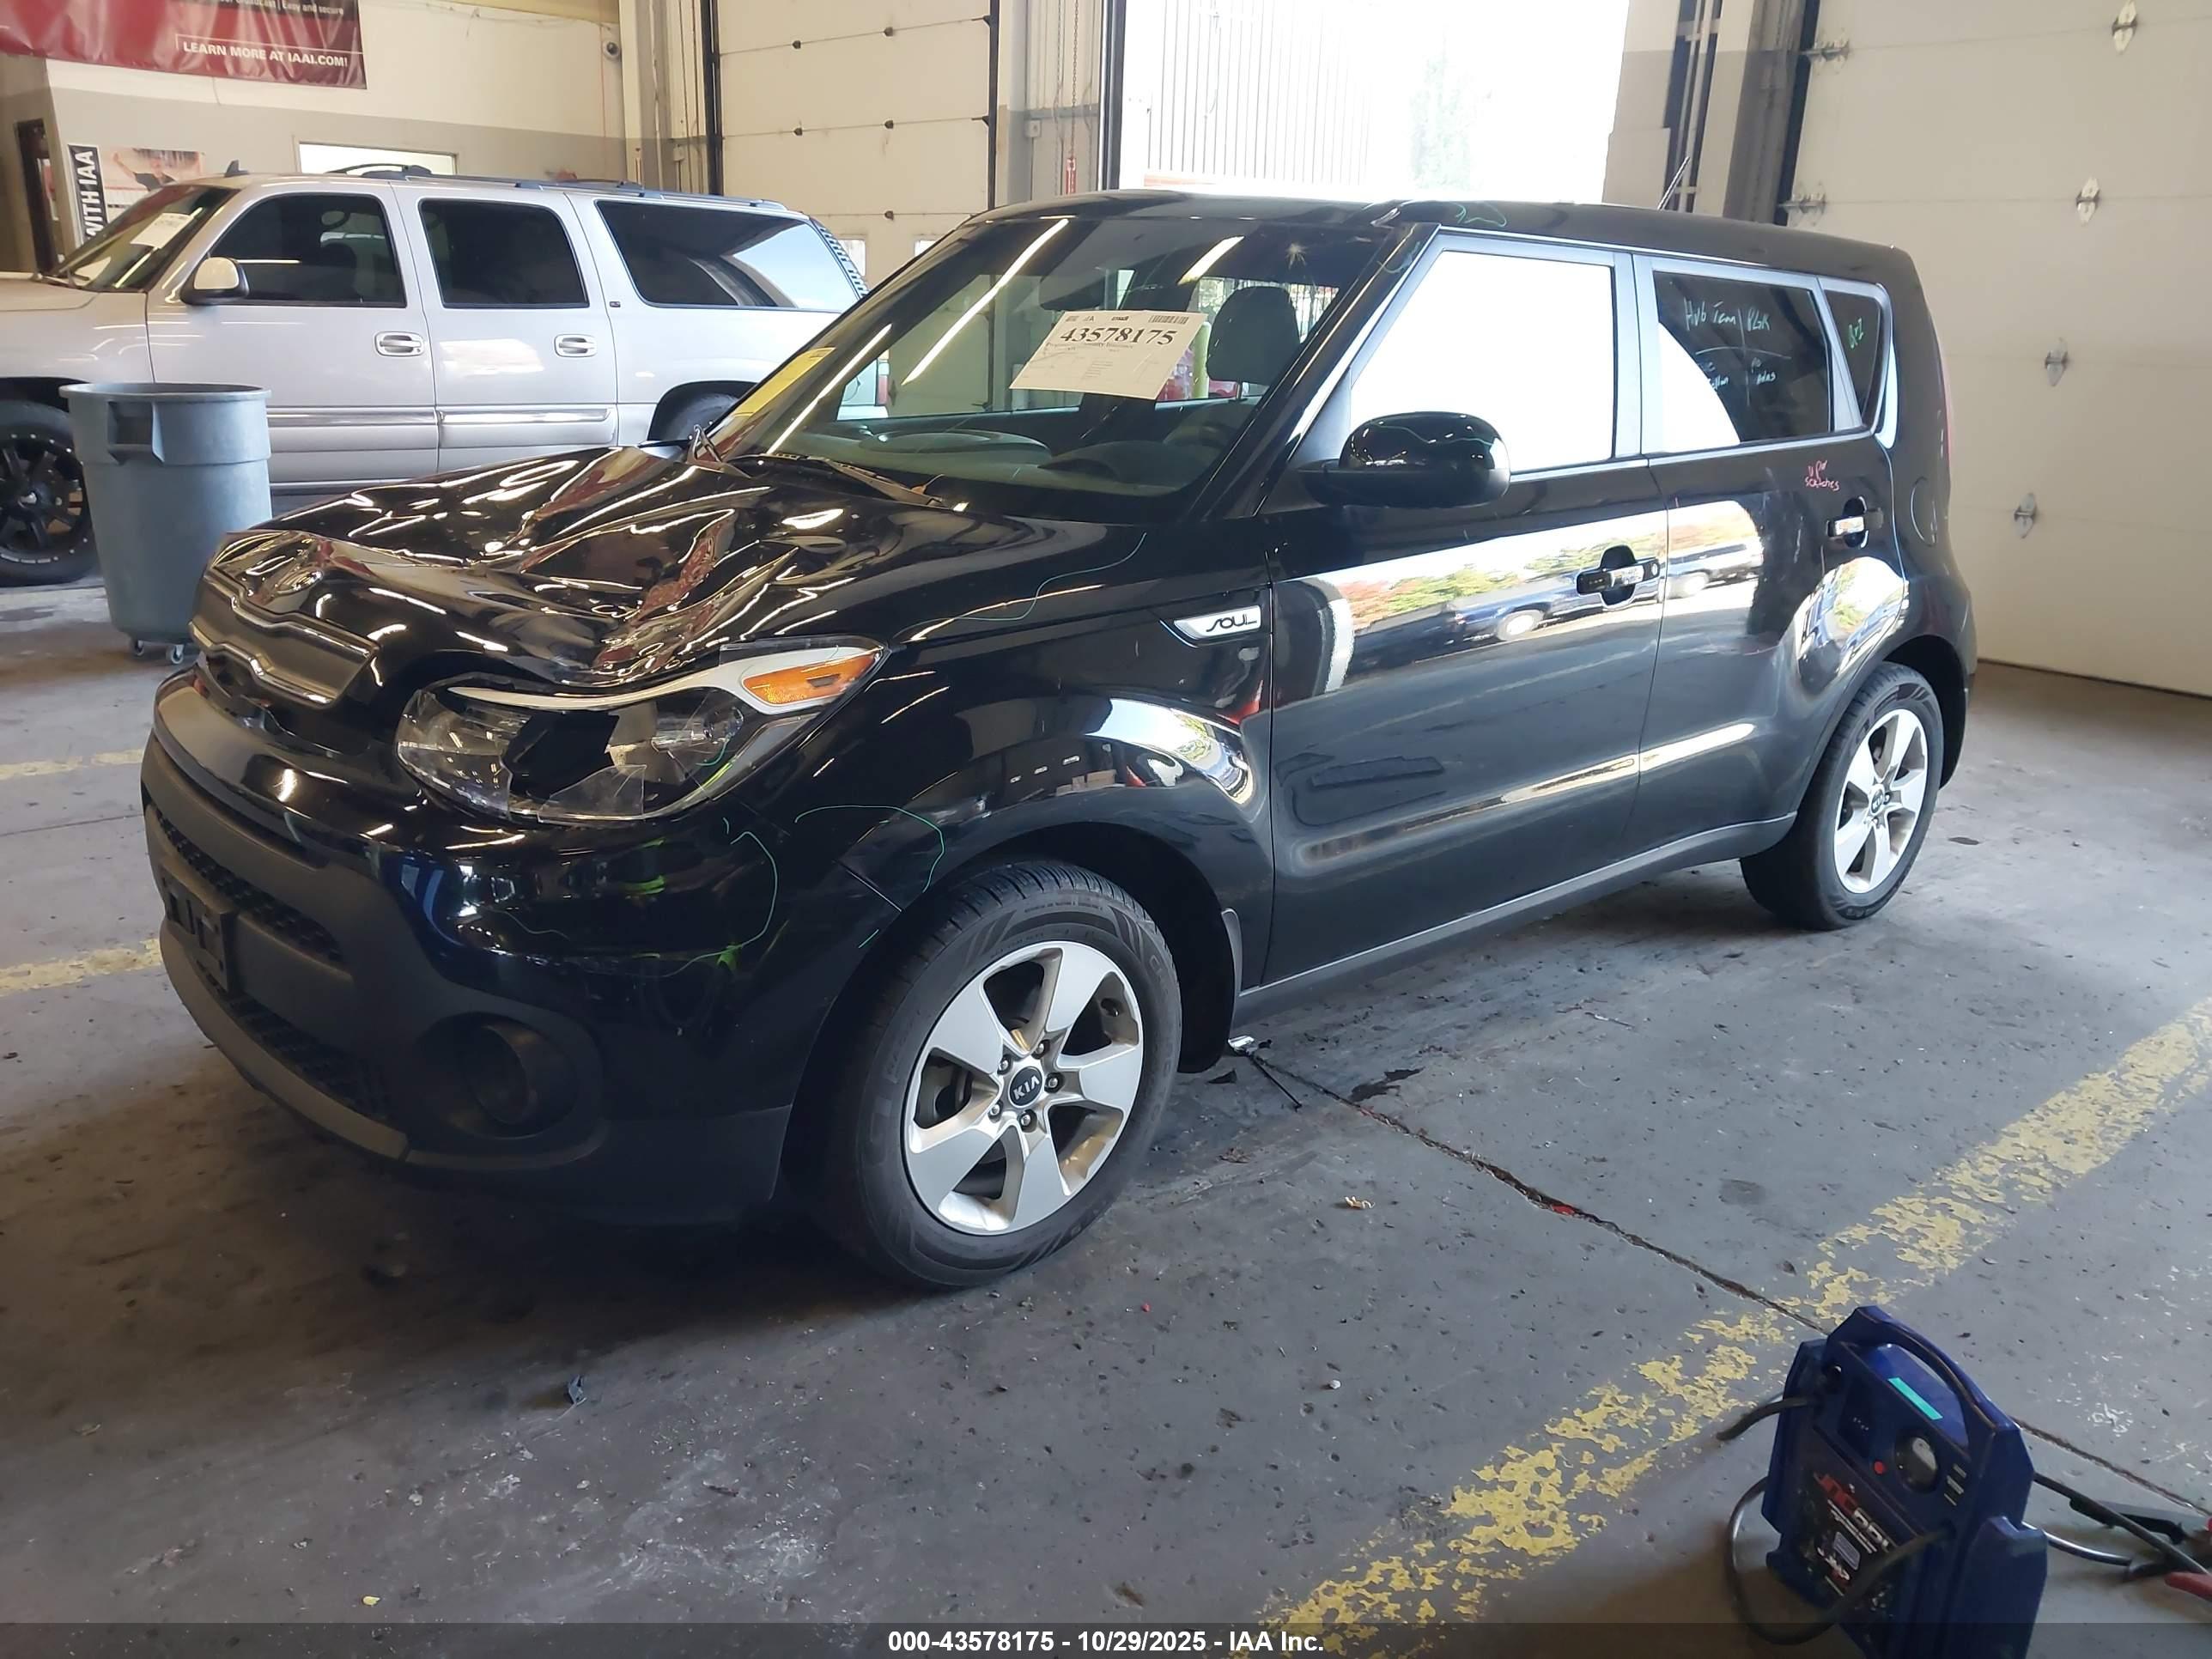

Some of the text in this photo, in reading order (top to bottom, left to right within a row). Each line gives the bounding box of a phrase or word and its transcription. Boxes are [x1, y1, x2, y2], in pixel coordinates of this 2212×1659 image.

[319, 5, 343, 15] secure
[183, 41, 349, 67] LEARN MORE AT IAAI.COM!
[75, 150, 98, 186] IAA
[1060, 327, 1178, 345] 43578175
[1012, 1075, 1041, 1100] KIA
